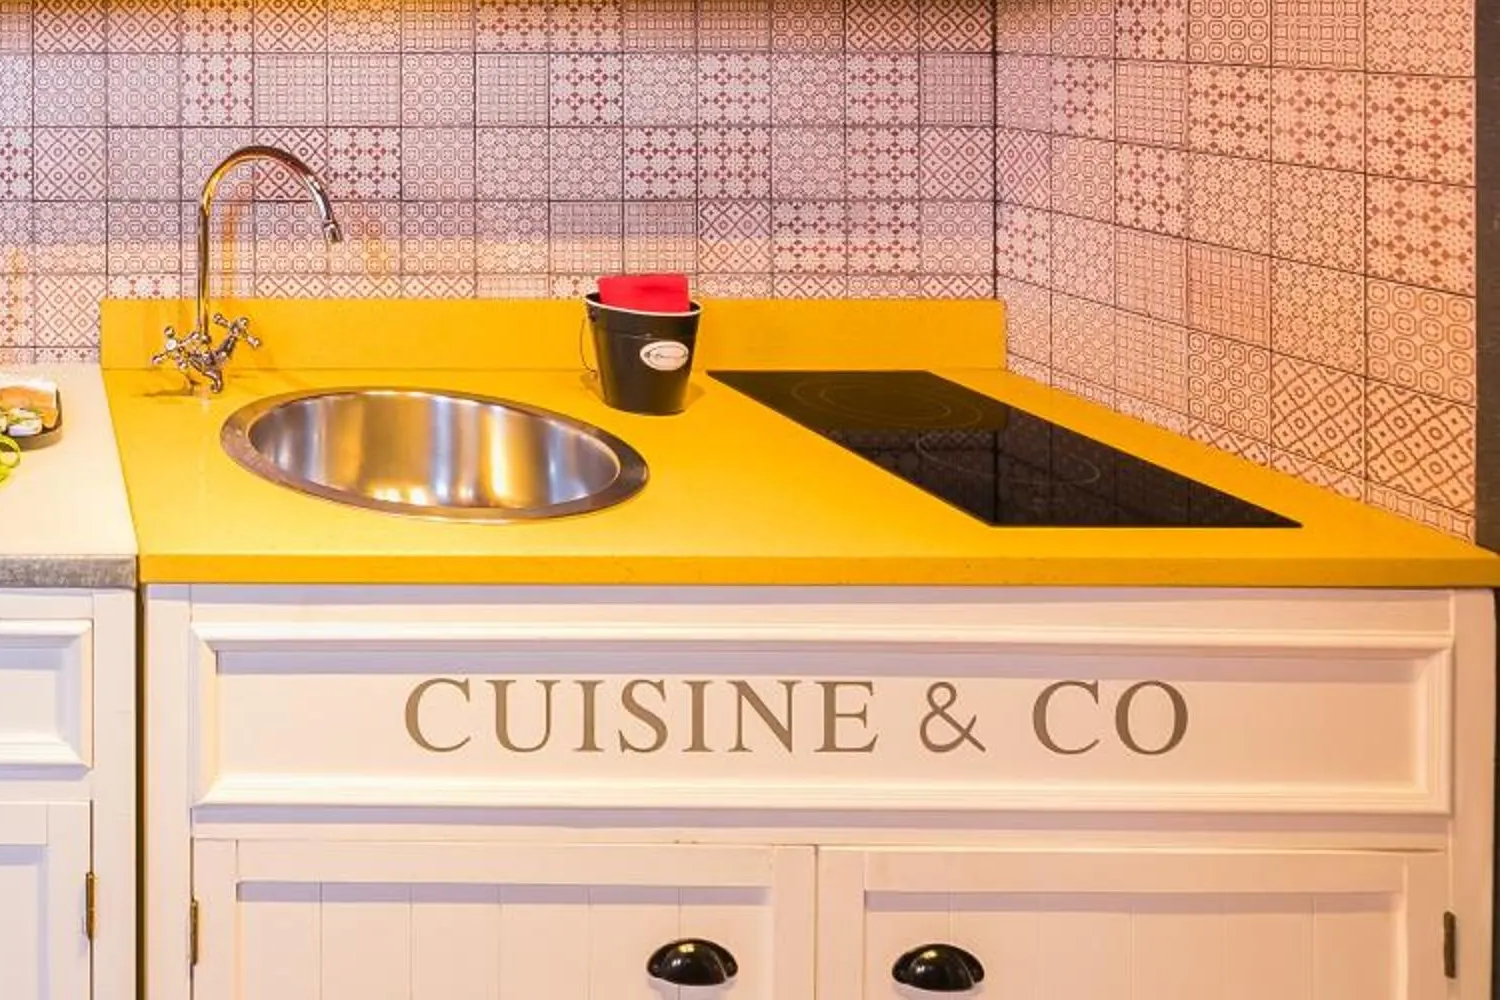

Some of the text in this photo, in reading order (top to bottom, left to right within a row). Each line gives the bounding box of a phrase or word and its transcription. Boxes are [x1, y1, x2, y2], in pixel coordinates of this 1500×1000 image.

[404, 678, 1191, 756] CUISINE & CO
